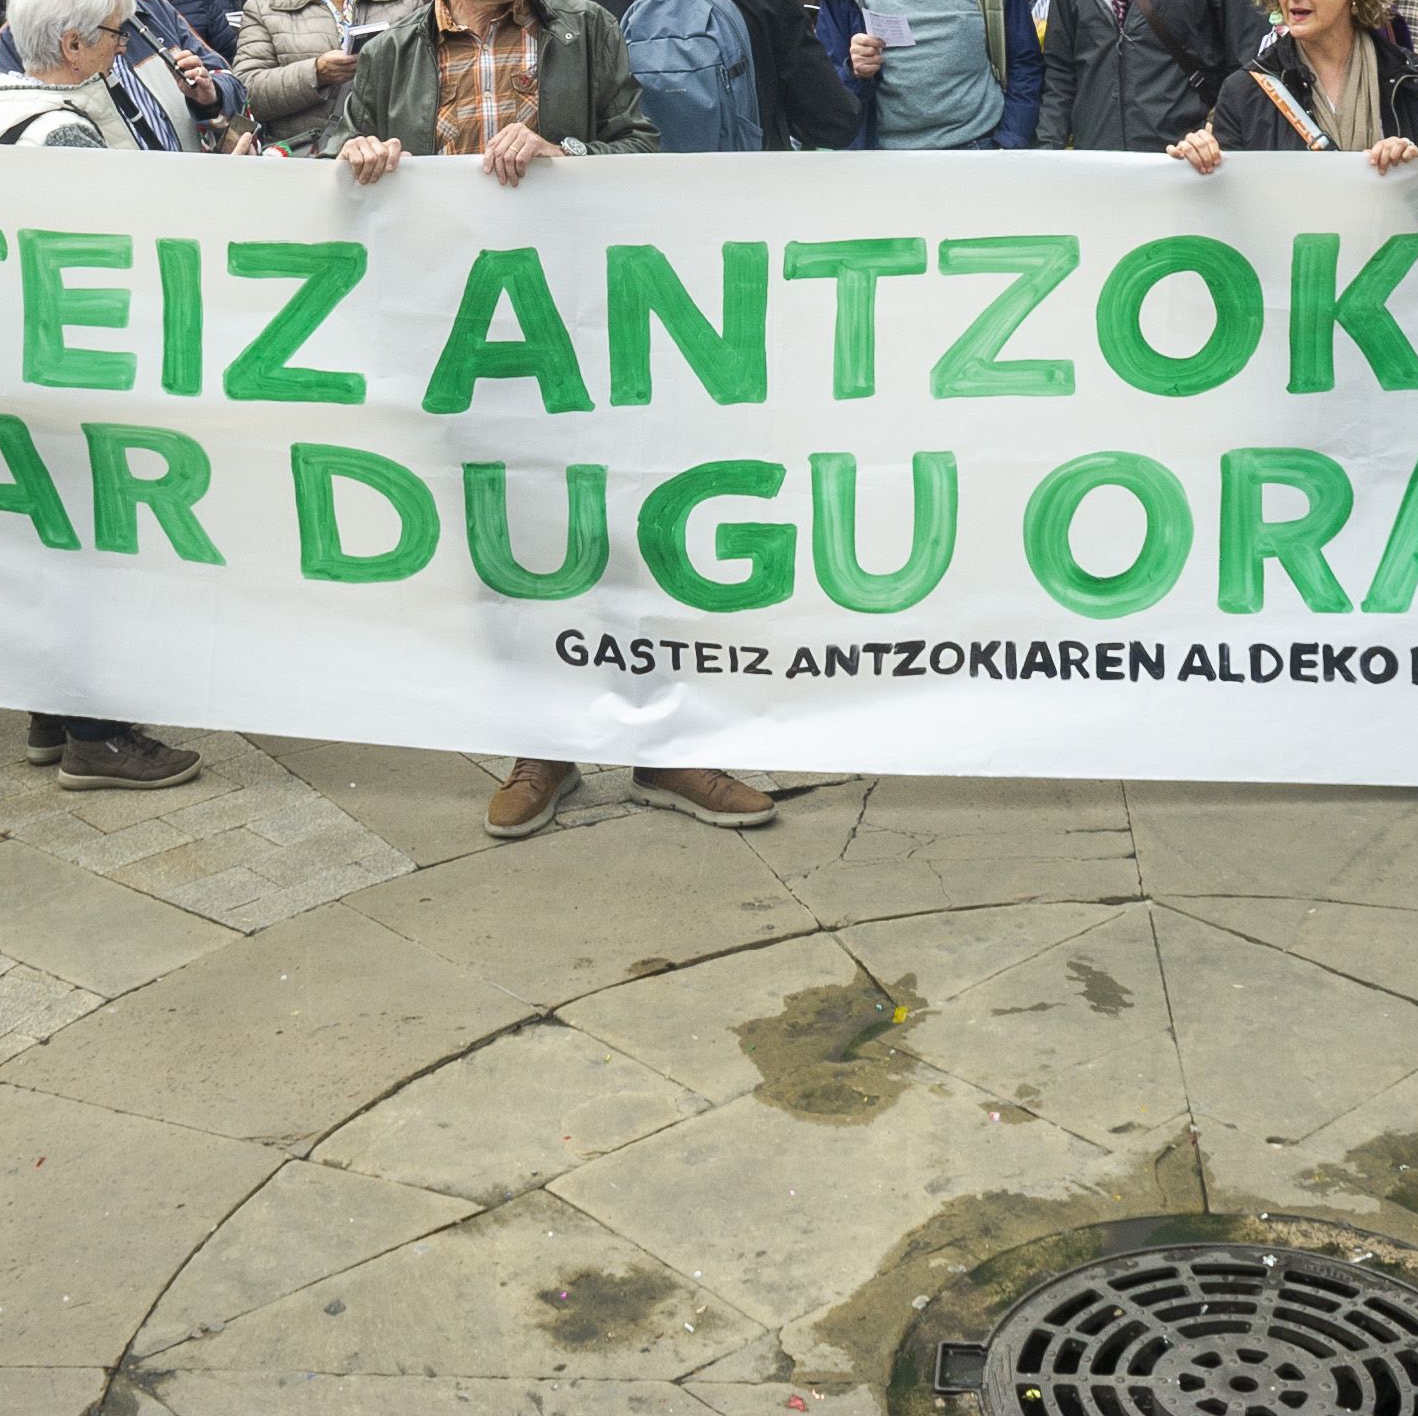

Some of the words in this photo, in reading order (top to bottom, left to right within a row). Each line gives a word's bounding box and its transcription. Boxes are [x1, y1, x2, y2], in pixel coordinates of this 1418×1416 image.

[290, 442, 959, 615] DUGU
[555, 629, 773, 675] GASTEIZ
[785, 640, 1165, 682] ANTZOKIAREN
[1177, 642, 1399, 685] ALDEKO
